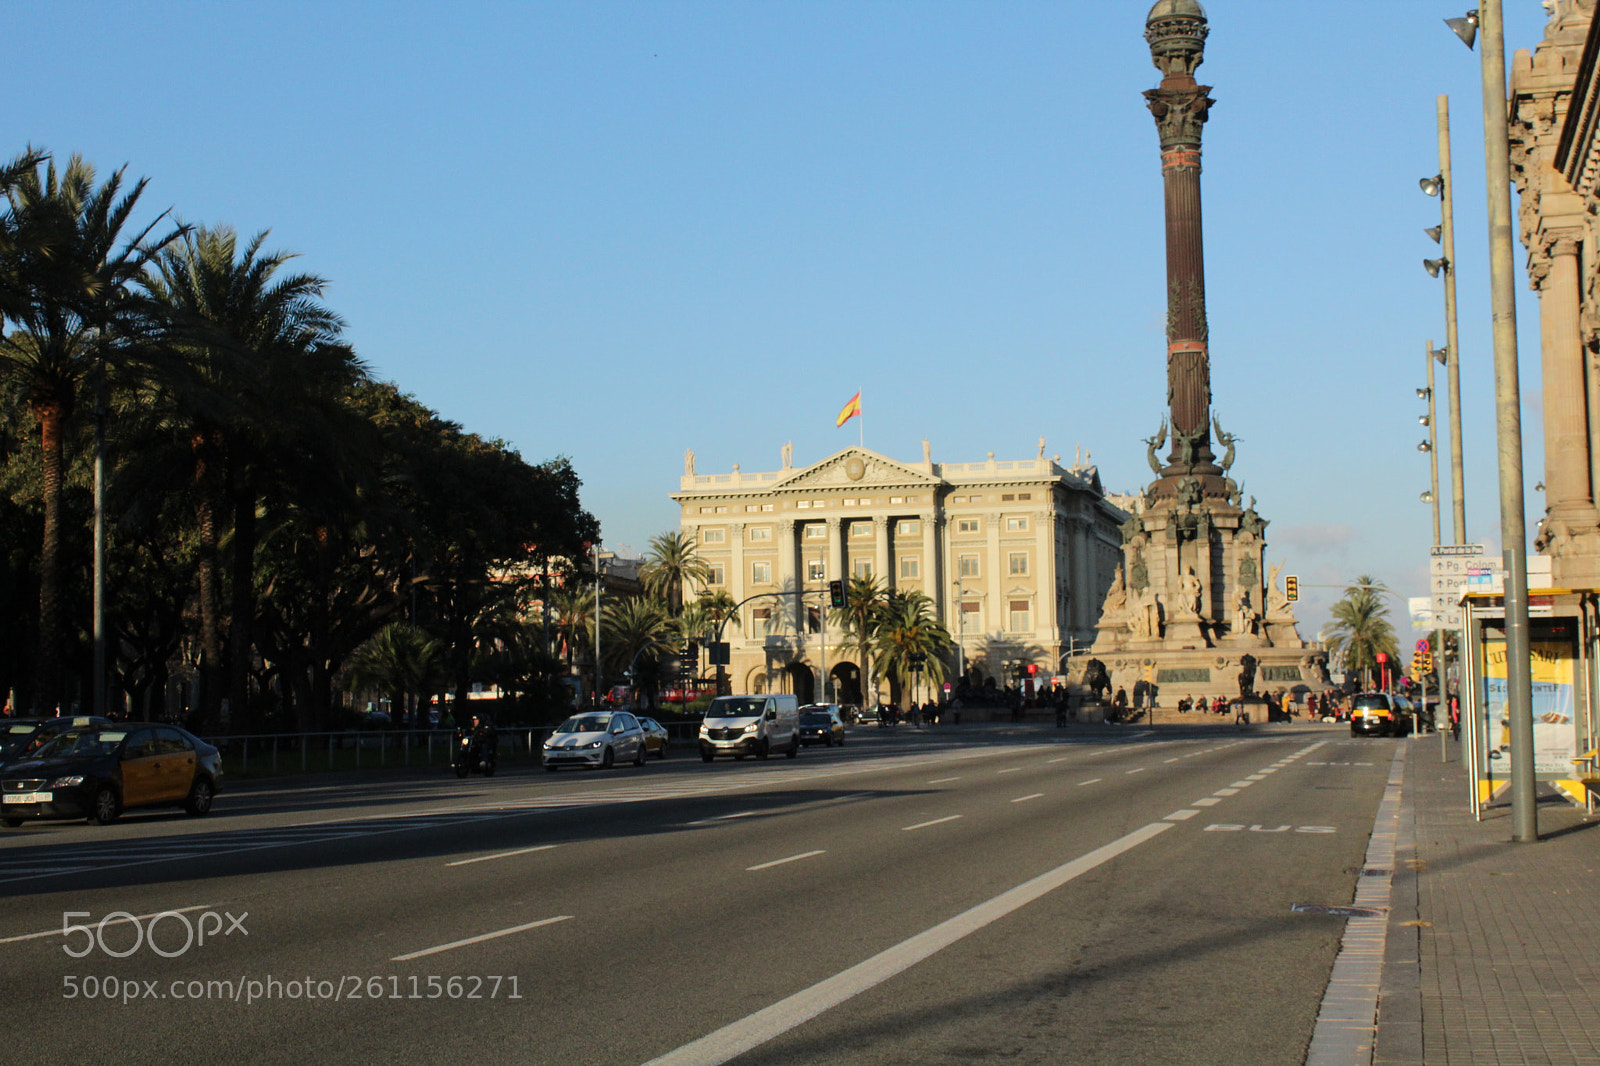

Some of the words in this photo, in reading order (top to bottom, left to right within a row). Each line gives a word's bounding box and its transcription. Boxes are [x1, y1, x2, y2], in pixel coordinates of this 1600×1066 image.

[1446, 561, 1462, 572] Pg.
[1465, 560, 1497, 569] Colom
[1203, 823, 1337, 833] BUS
